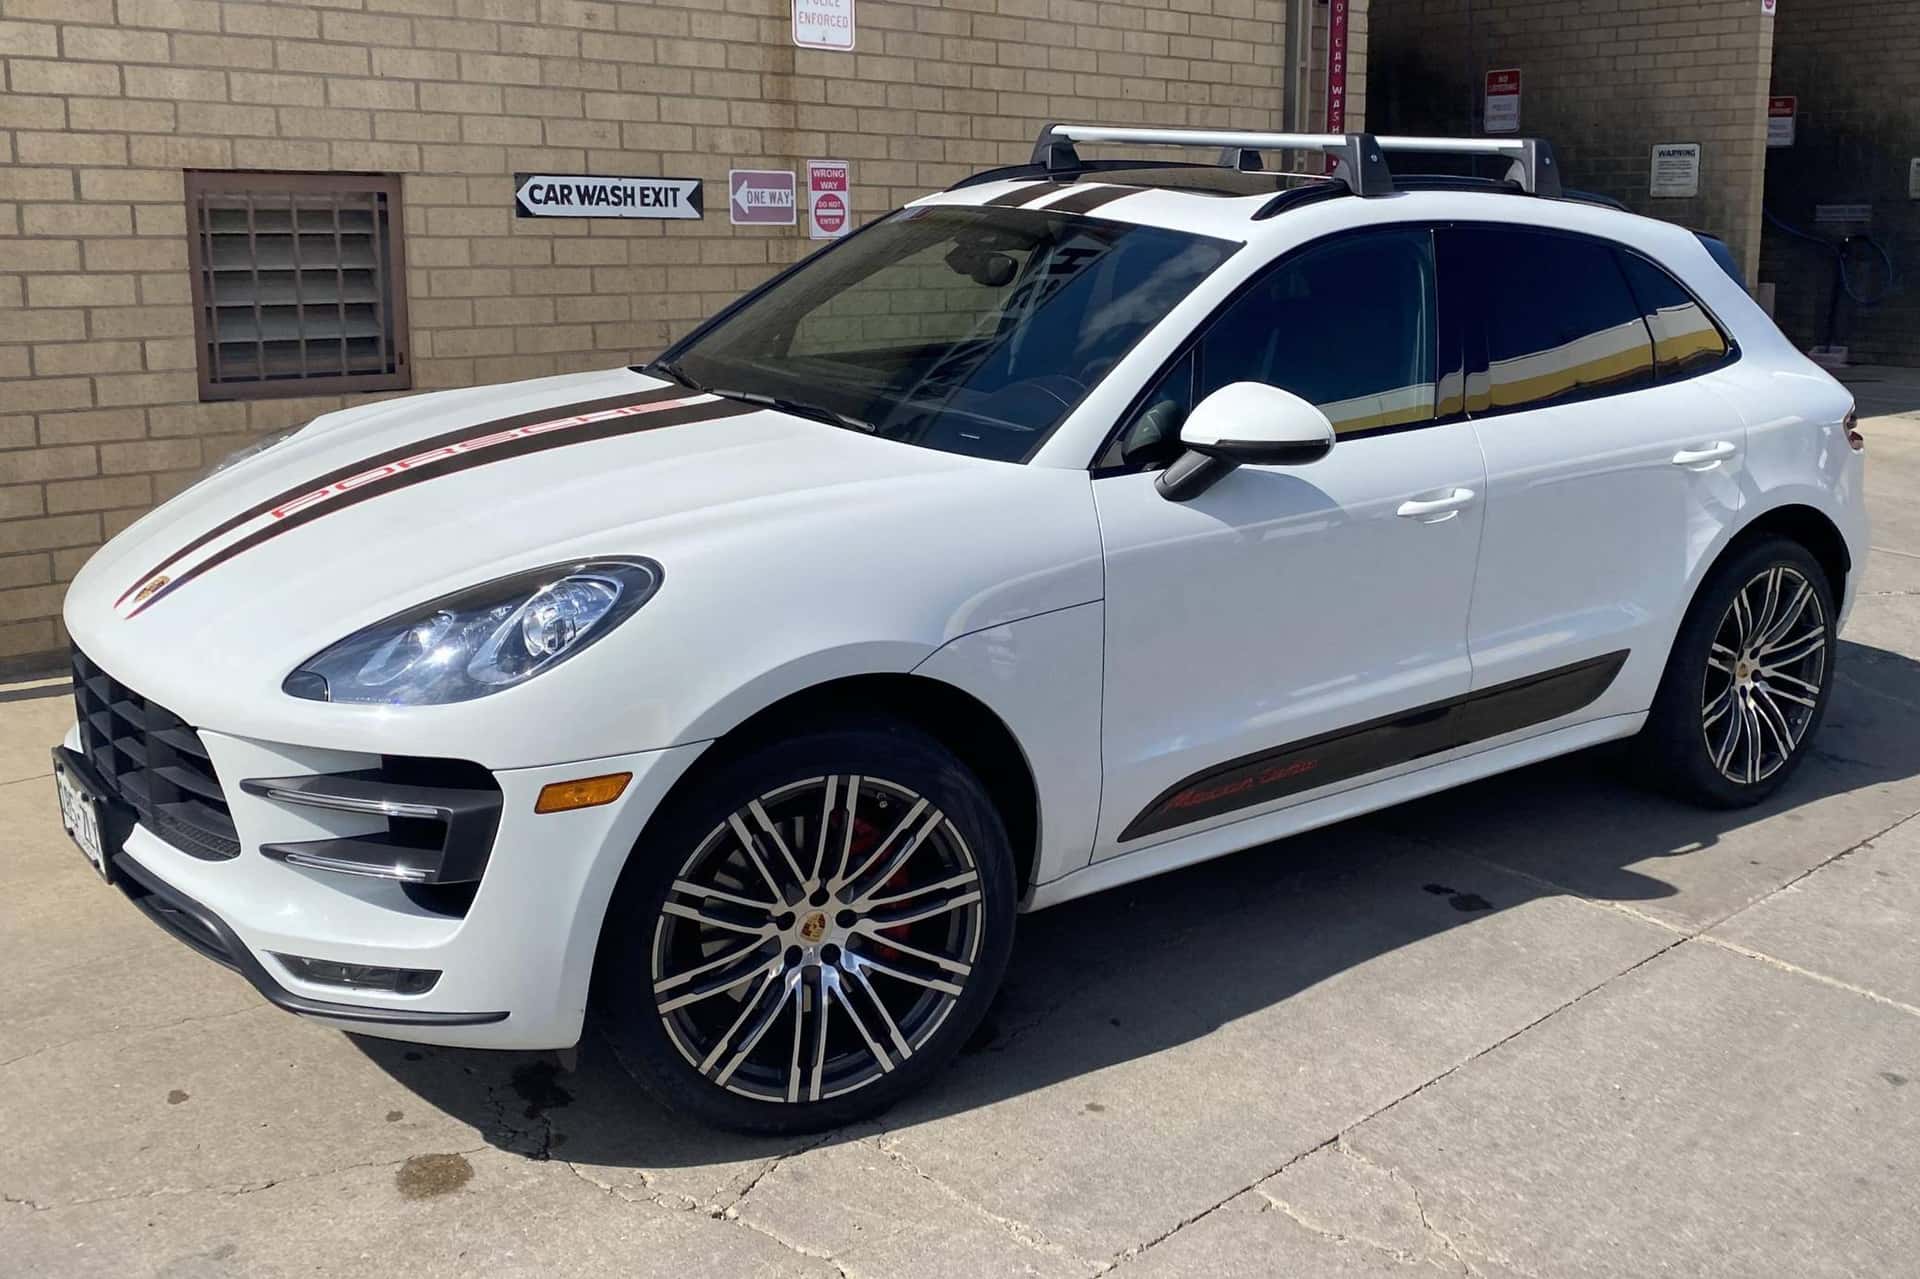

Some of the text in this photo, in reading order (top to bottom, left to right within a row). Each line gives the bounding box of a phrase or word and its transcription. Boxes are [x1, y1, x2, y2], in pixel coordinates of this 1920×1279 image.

[799, 11, 849, 28] ENFORCED
[1334, 38, 1342, 73] CAR
[1332, 85, 1343, 134] WASH
[813, 169, 845, 179] WRONG
[528, 183, 681, 208] CAR WASH EXIT
[820, 181, 838, 190] WAY
[746, 190, 791, 205] ONE WAY
[271, 399, 682, 518] PORSCHE
